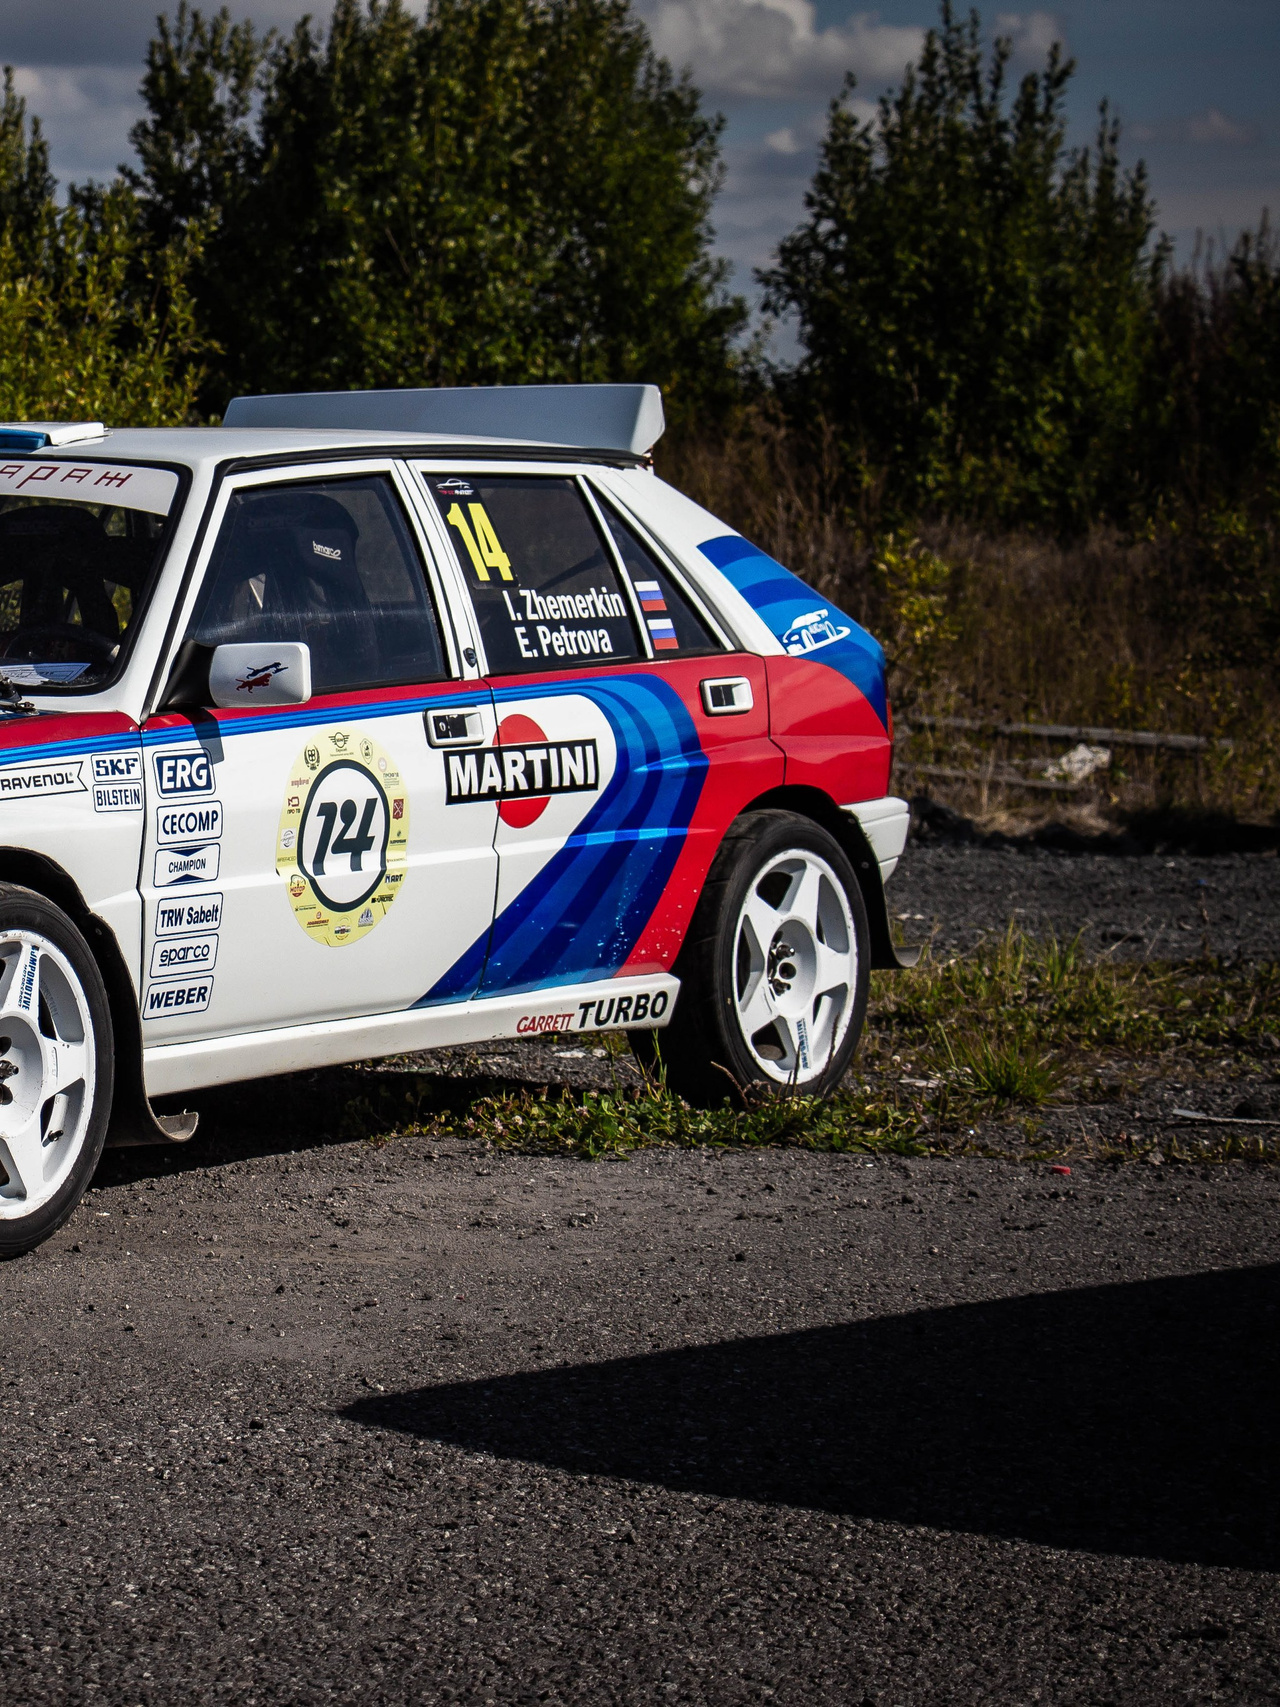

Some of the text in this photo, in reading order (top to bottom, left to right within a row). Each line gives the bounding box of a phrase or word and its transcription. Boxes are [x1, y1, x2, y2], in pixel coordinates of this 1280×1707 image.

[446, 502, 514, 581] 14
[502, 587, 627, 621] I. Zhemerkin
[514, 625, 613, 658] E. Petrova
[95, 757, 138, 777] SKF
[161, 757, 208, 790] ERG
[448, 745, 596, 797] MARTINI
[0, 773, 74, 792] RAVENOL
[96, 788, 141, 807] BILSTEIN
[162, 810, 219, 836] CECOMP
[316, 797, 378, 876] 14
[168, 858, 207, 874] CHAMPION
[160, 903, 219, 928] TRW Sabelt
[159, 943, 210, 967] sparco
[149, 986, 208, 1010] WEBER
[578, 990, 669, 1029] TURBO
[516, 1013, 575, 1034] GARRETT
